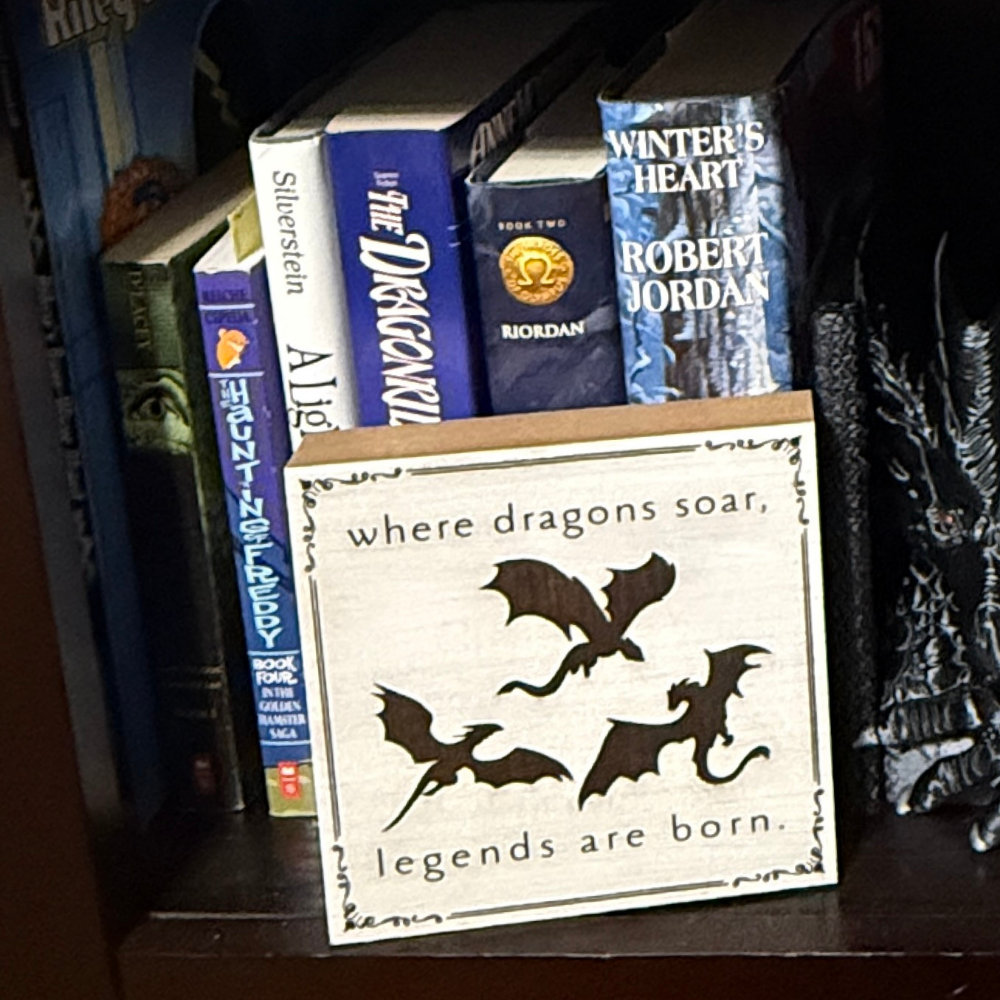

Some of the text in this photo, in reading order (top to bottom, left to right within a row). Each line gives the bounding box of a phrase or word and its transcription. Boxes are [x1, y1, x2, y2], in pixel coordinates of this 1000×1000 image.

[608, 121, 765, 160] WINTER'S
[634, 158, 744, 194] HEART
[272, 169, 307, 295] Silverstein
[368, 190, 408, 236] THE
[622, 232, 769, 275] ROBERT
[626, 270, 770, 313] JORDAN
[501, 321, 585, 340] RIORDAN
[287, 344, 333, 371] A
[347, 491, 767, 548] where dragons soar,
[244, 541, 283, 649] FREDDY
[252, 656, 297, 672] BOOK
[256, 671, 298, 685] FOUR
[377, 812, 785, 883] legends are born.
